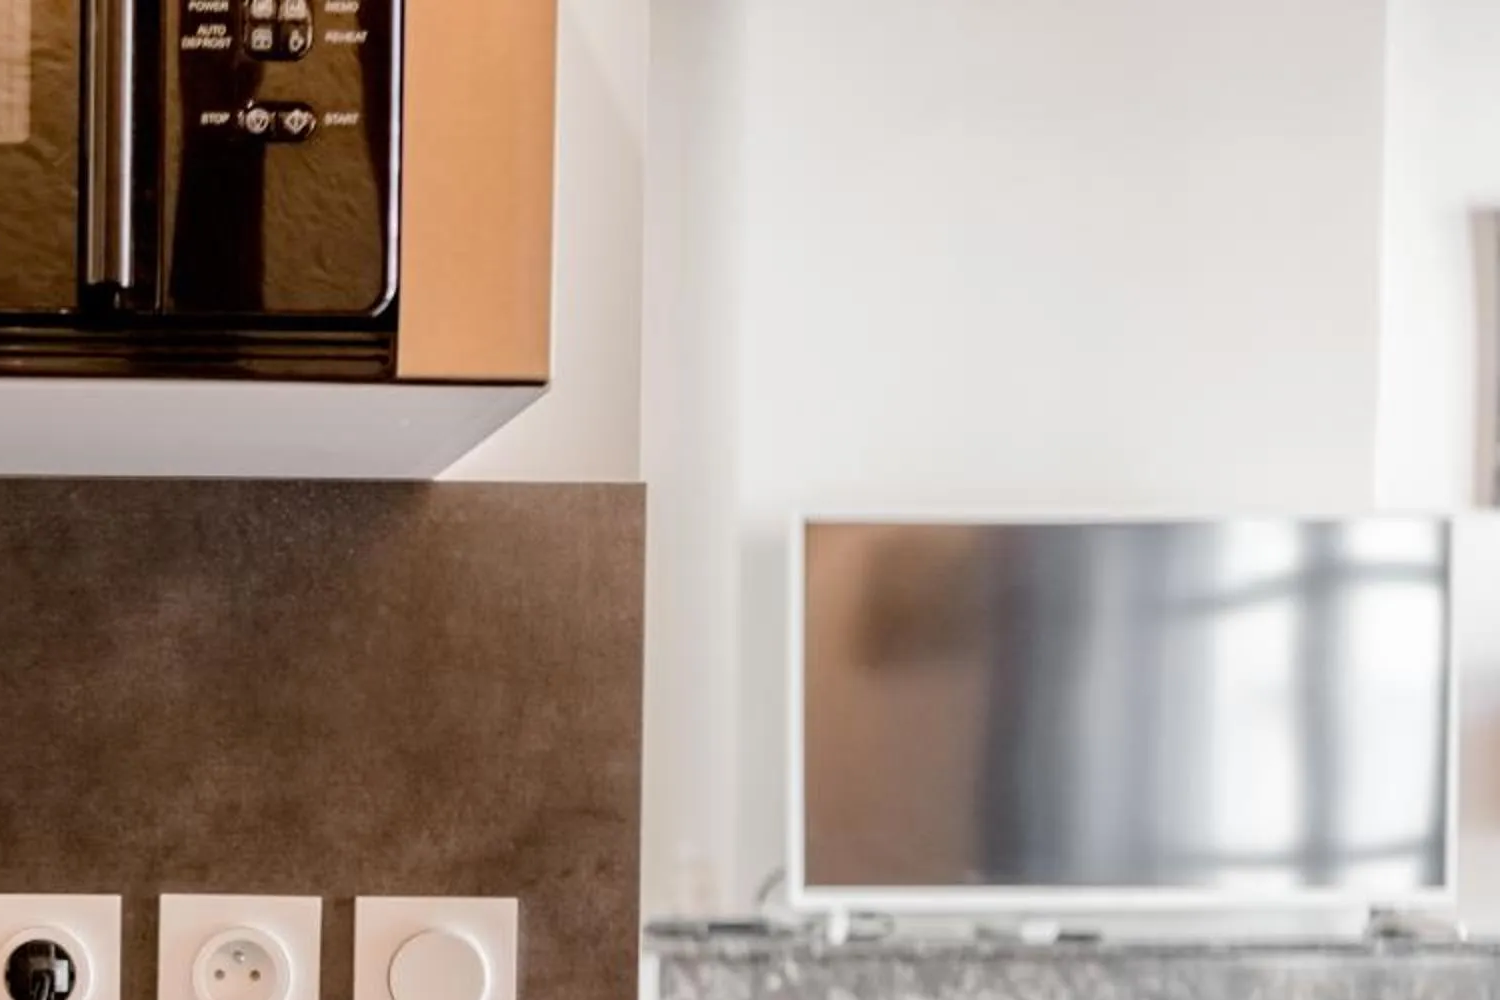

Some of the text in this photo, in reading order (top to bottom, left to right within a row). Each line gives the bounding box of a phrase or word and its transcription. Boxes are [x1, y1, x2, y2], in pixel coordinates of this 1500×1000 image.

[187, 0, 229, 12] POWER
[197, 24, 227, 36] AUTO
[181, 36, 232, 49] DEFROST
[200, 112, 230, 125] STOP
[324, 112, 359, 125] START
